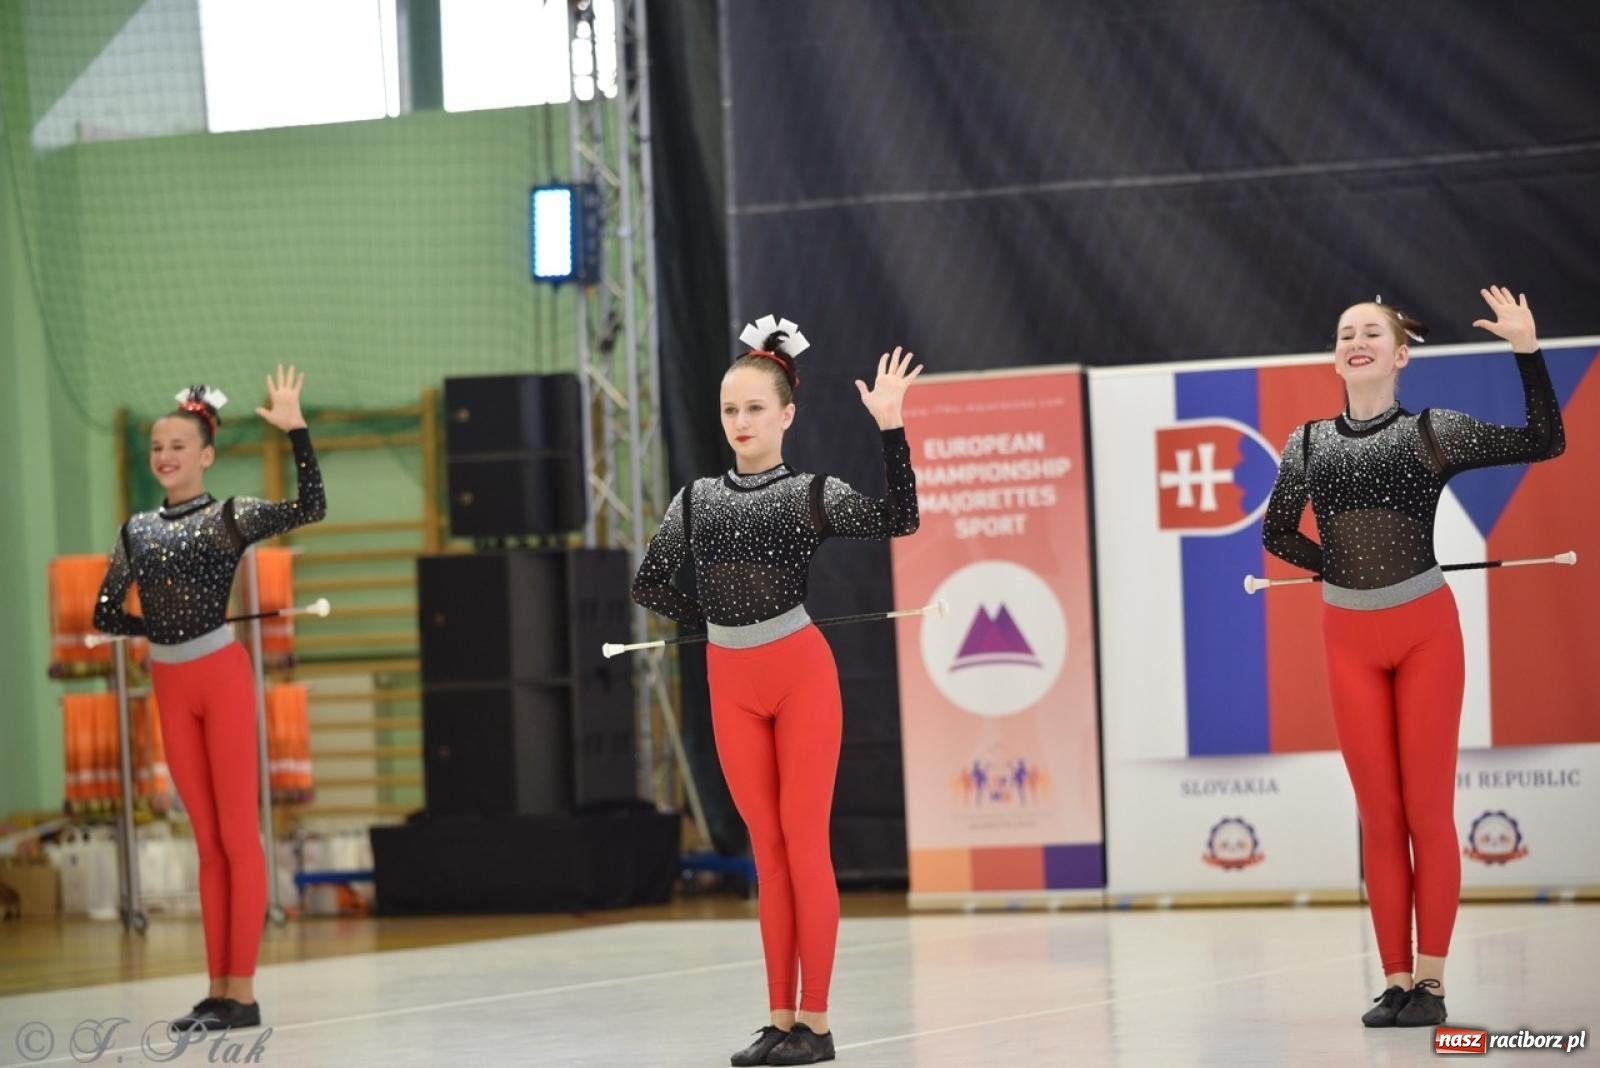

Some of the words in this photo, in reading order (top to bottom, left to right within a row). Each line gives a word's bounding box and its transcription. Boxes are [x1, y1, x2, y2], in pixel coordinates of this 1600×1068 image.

[923, 432, 1044, 460] EUROPEAN
[912, 457, 1071, 486] HAMPIONSHIP
[918, 484, 1056, 514] MAJORETTES
[954, 513, 1027, 539] SPORT
[1180, 777, 1280, 797] SLOVAKIA
[1478, 768, 1581, 789] REPUBLIC
